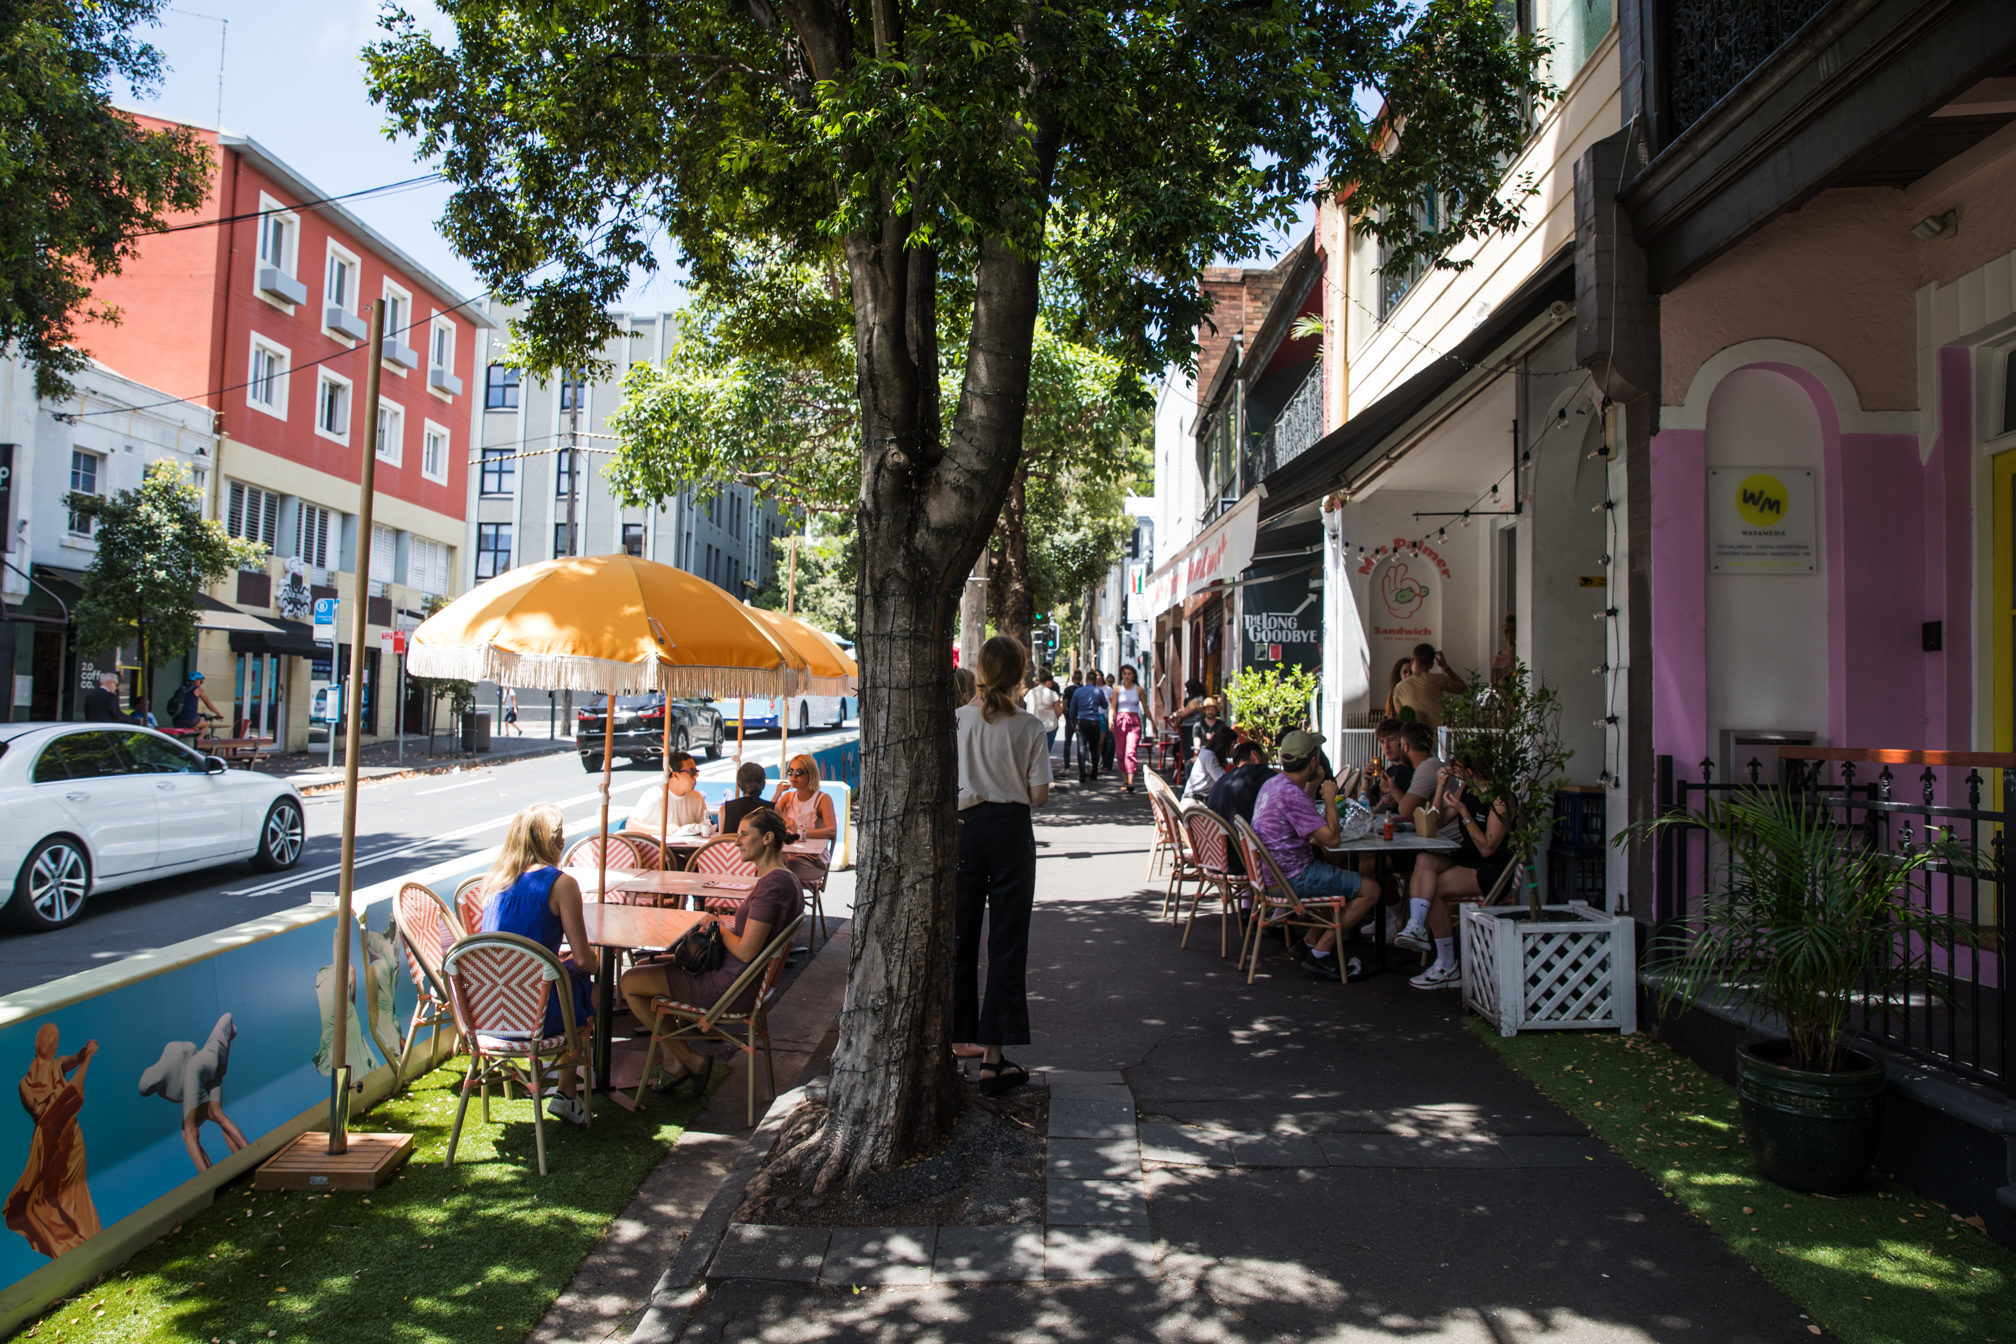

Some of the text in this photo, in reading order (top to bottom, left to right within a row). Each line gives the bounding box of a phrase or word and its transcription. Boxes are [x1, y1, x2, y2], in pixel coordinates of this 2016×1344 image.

[1393, 538, 1451, 579] Palmer
[1243, 612, 1298, 630] THE LONG
[1248, 624, 1318, 643] GOODBYE
[1373, 626, 1432, 636] Sandwich
[81, 670, 105, 680] coff
[80, 681, 95, 689] co.
